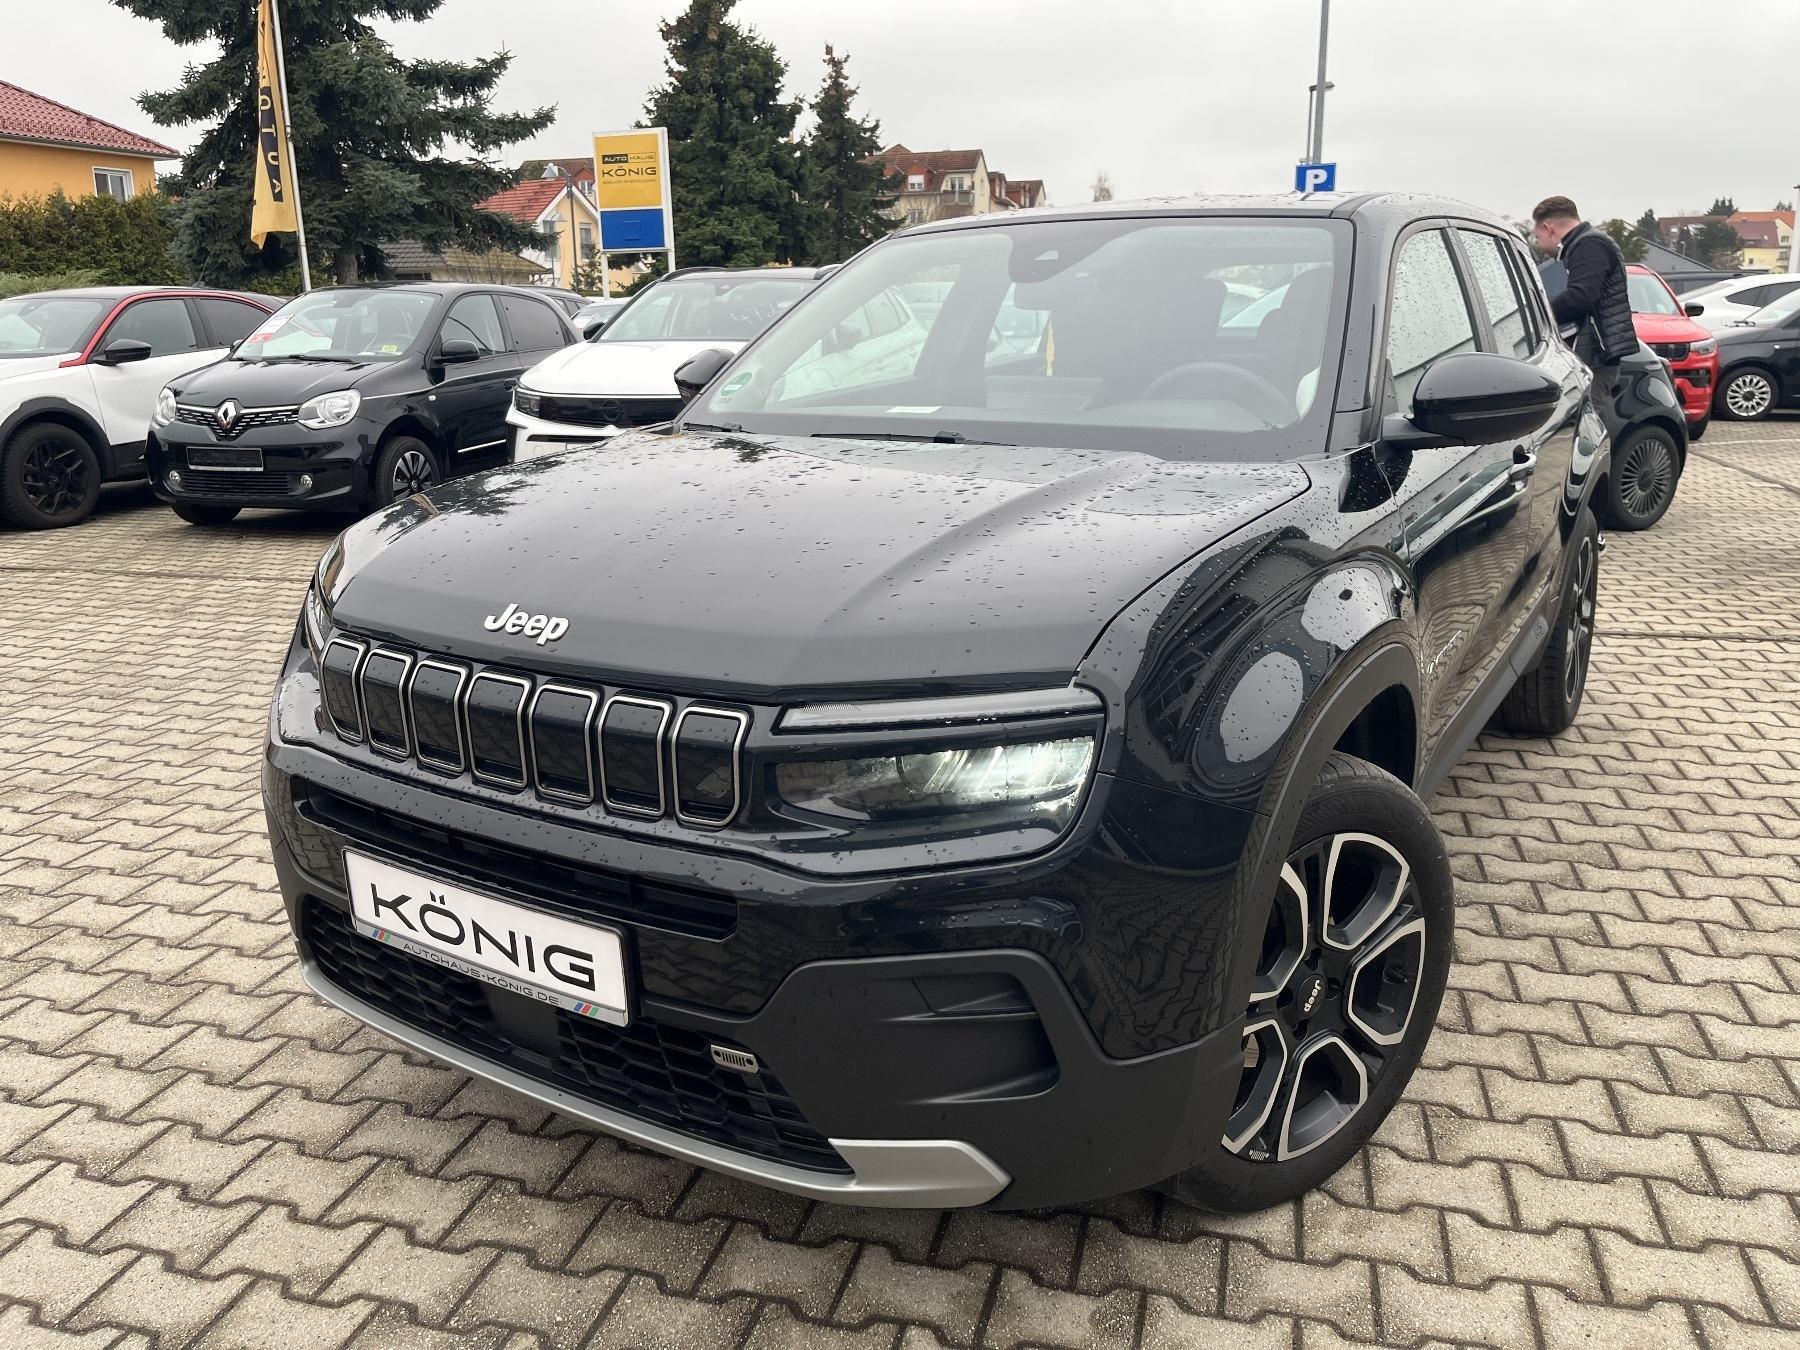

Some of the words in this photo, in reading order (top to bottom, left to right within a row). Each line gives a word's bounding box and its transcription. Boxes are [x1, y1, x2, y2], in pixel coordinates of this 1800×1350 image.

[602, 166, 656, 178] KÖNIG
[1305, 169, 1328, 192] P
[484, 603, 570, 646] Jeep
[371, 882, 596, 992] KÖNIG
[1303, 979, 1322, 1012] Jeep
